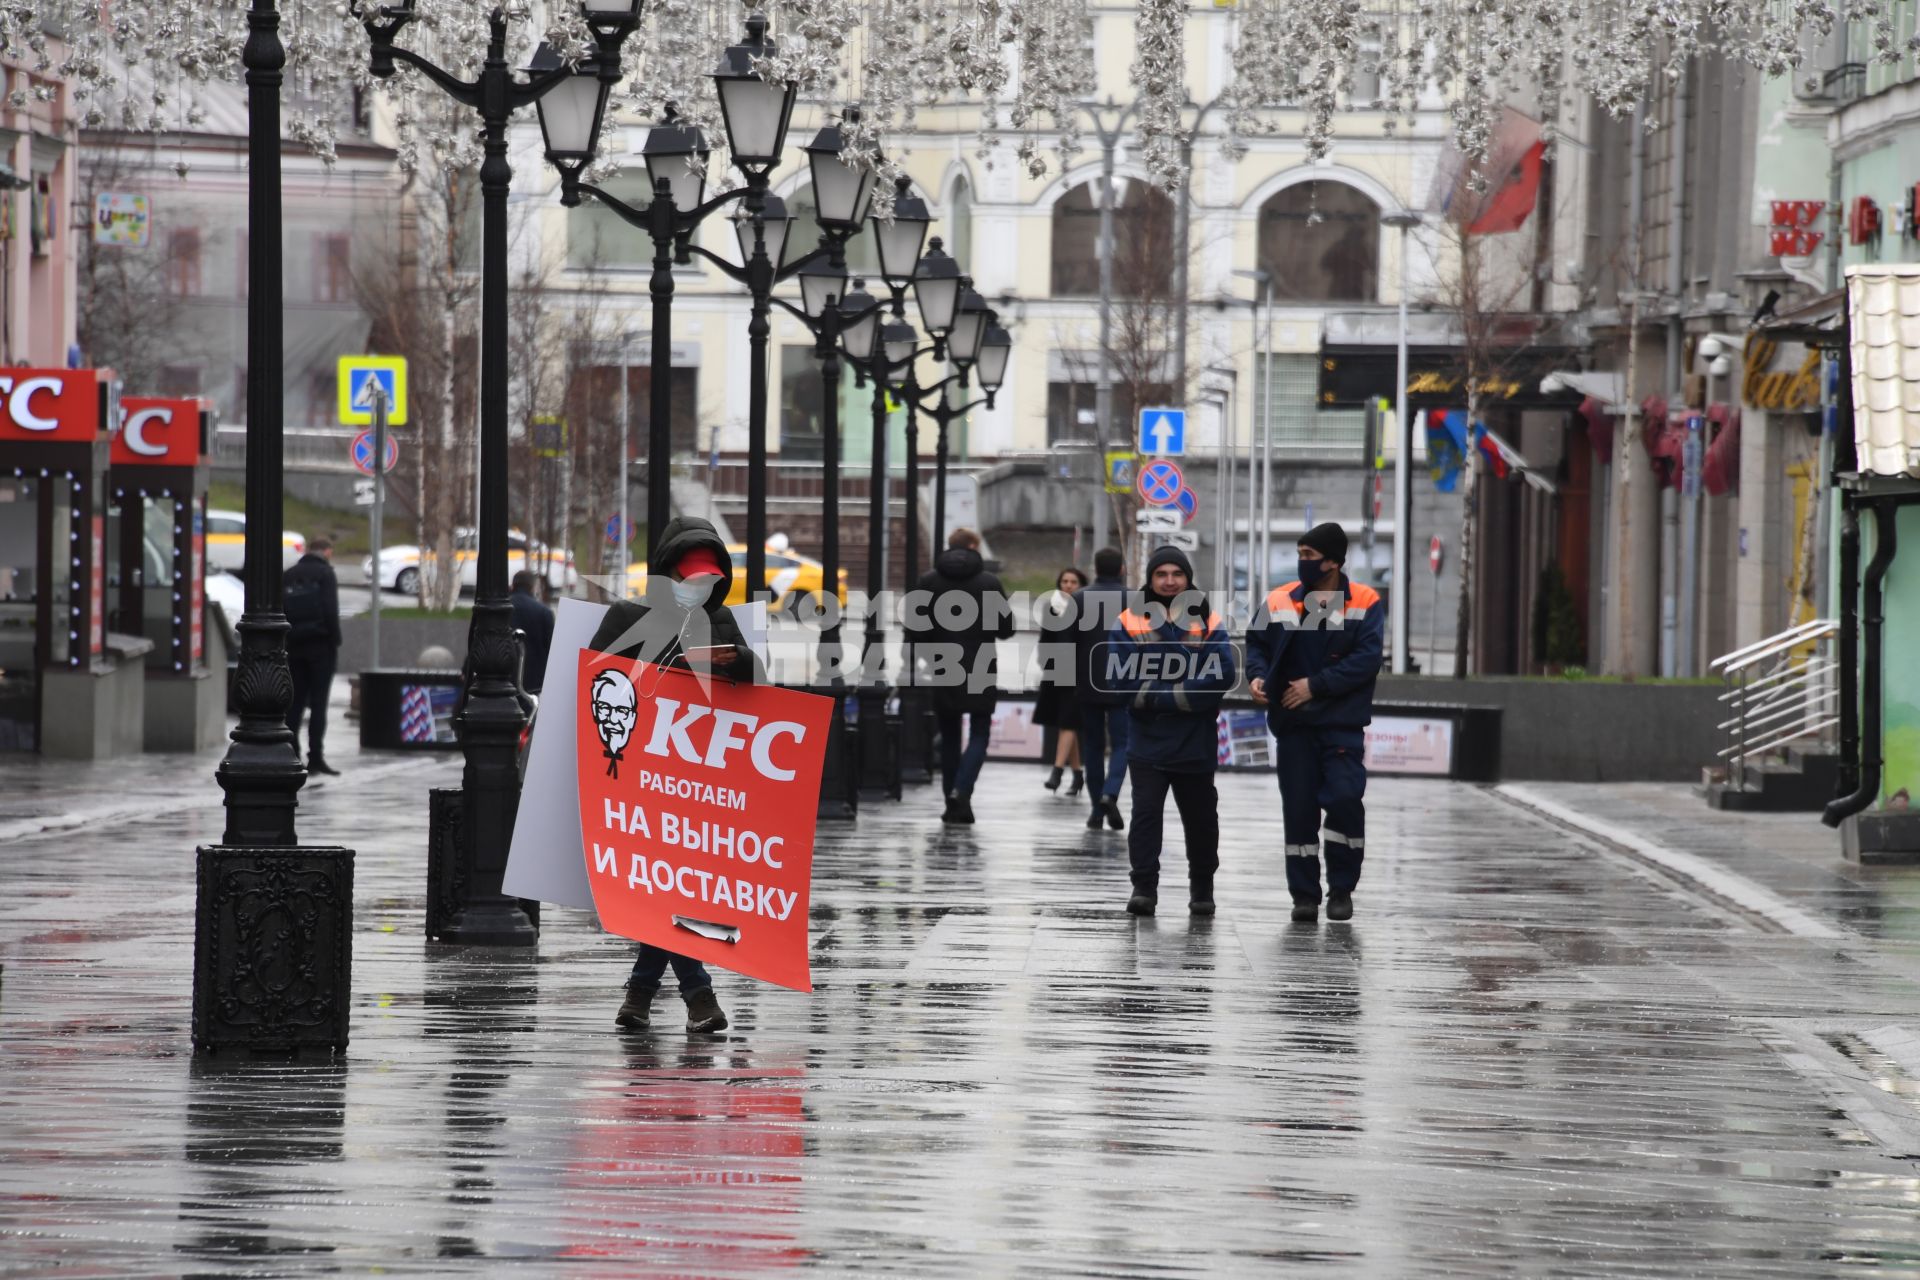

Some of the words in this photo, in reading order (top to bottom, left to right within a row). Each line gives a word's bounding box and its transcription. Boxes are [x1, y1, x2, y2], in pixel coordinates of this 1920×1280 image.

[643, 696, 807, 782] KFC
[639, 769, 746, 811] РАБОТАЕМ
[604, 797, 651, 839] НА
[661, 812, 784, 869] ВЫНОС
[593, 843, 618, 878] И
[627, 854, 798, 921] ДОСТАВКУ
